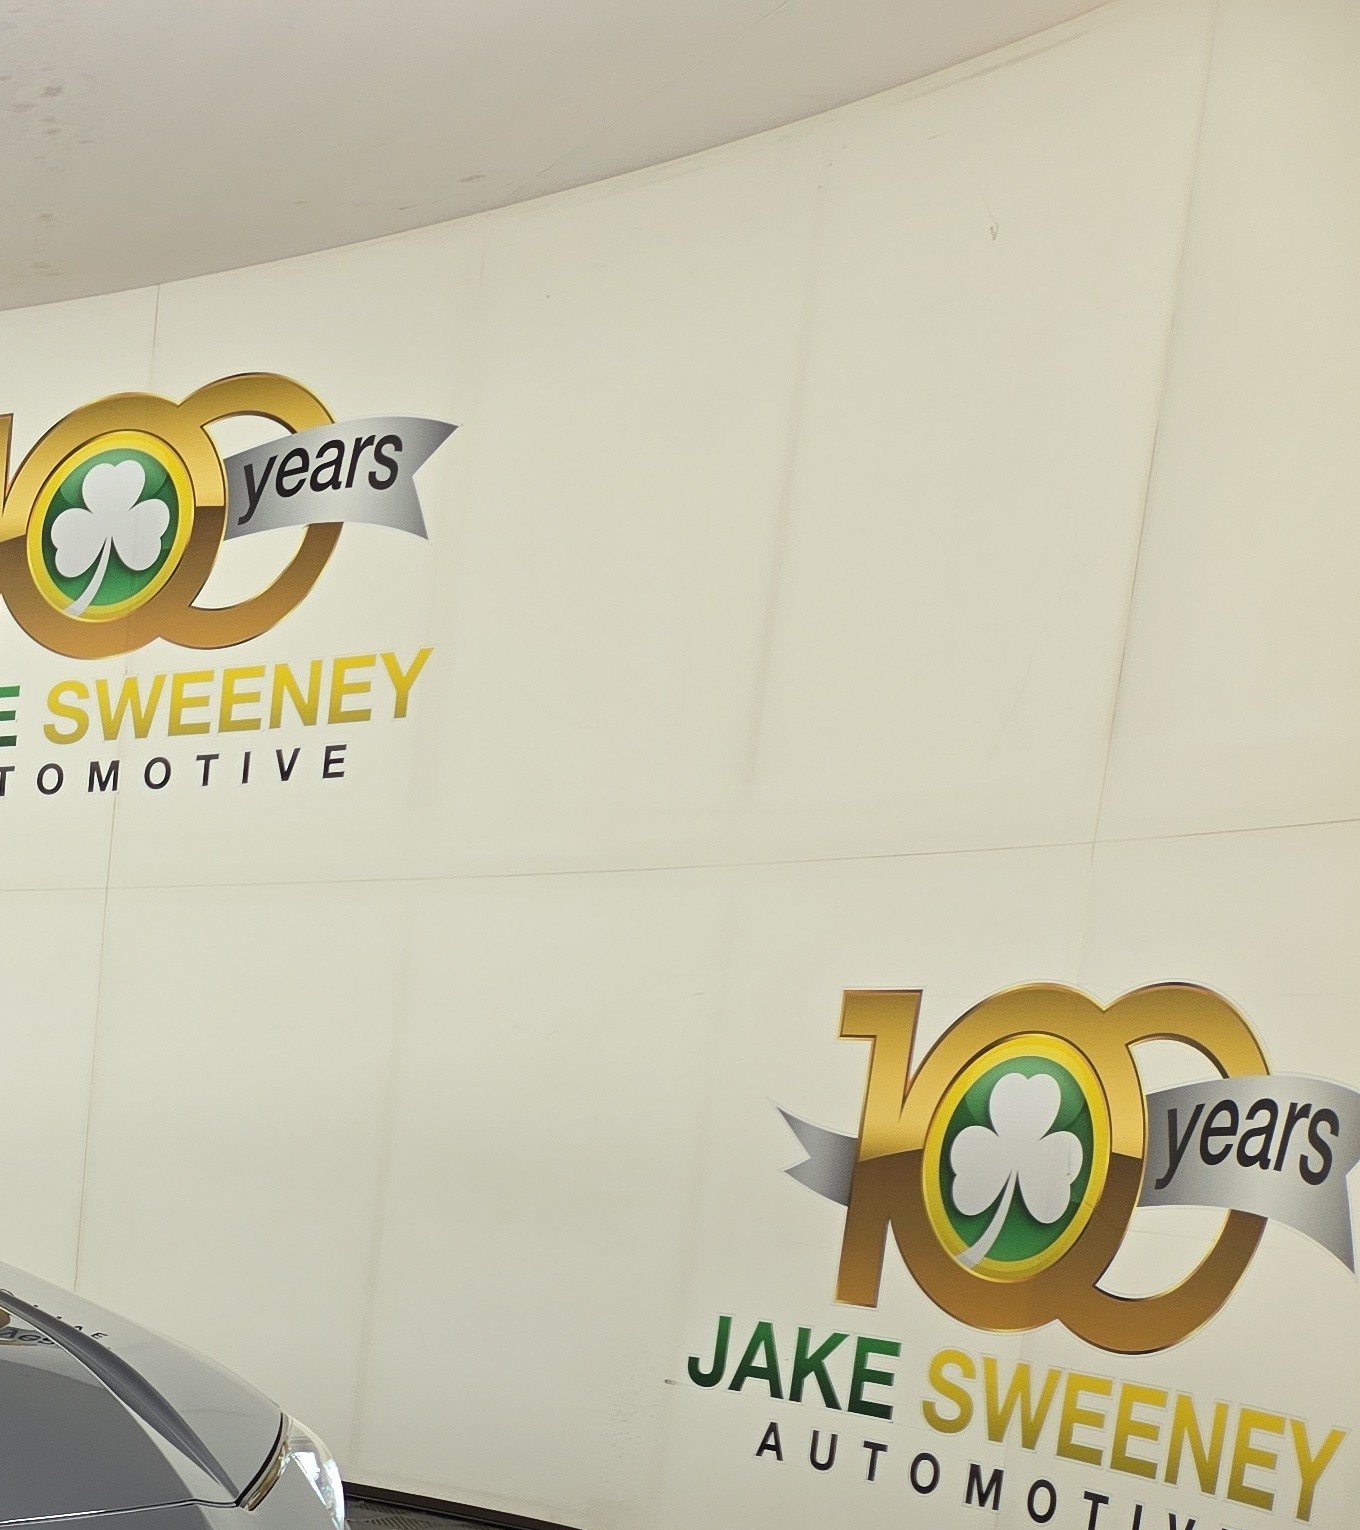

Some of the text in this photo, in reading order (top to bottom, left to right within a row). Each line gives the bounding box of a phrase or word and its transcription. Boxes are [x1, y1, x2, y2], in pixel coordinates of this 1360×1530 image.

[237, 431, 403, 526] years
[42, 647, 434, 746] SWEENEY
[1155, 1098, 1340, 1190] years
[687, 1315, 1346, 1522] JAKE SWEENEY
